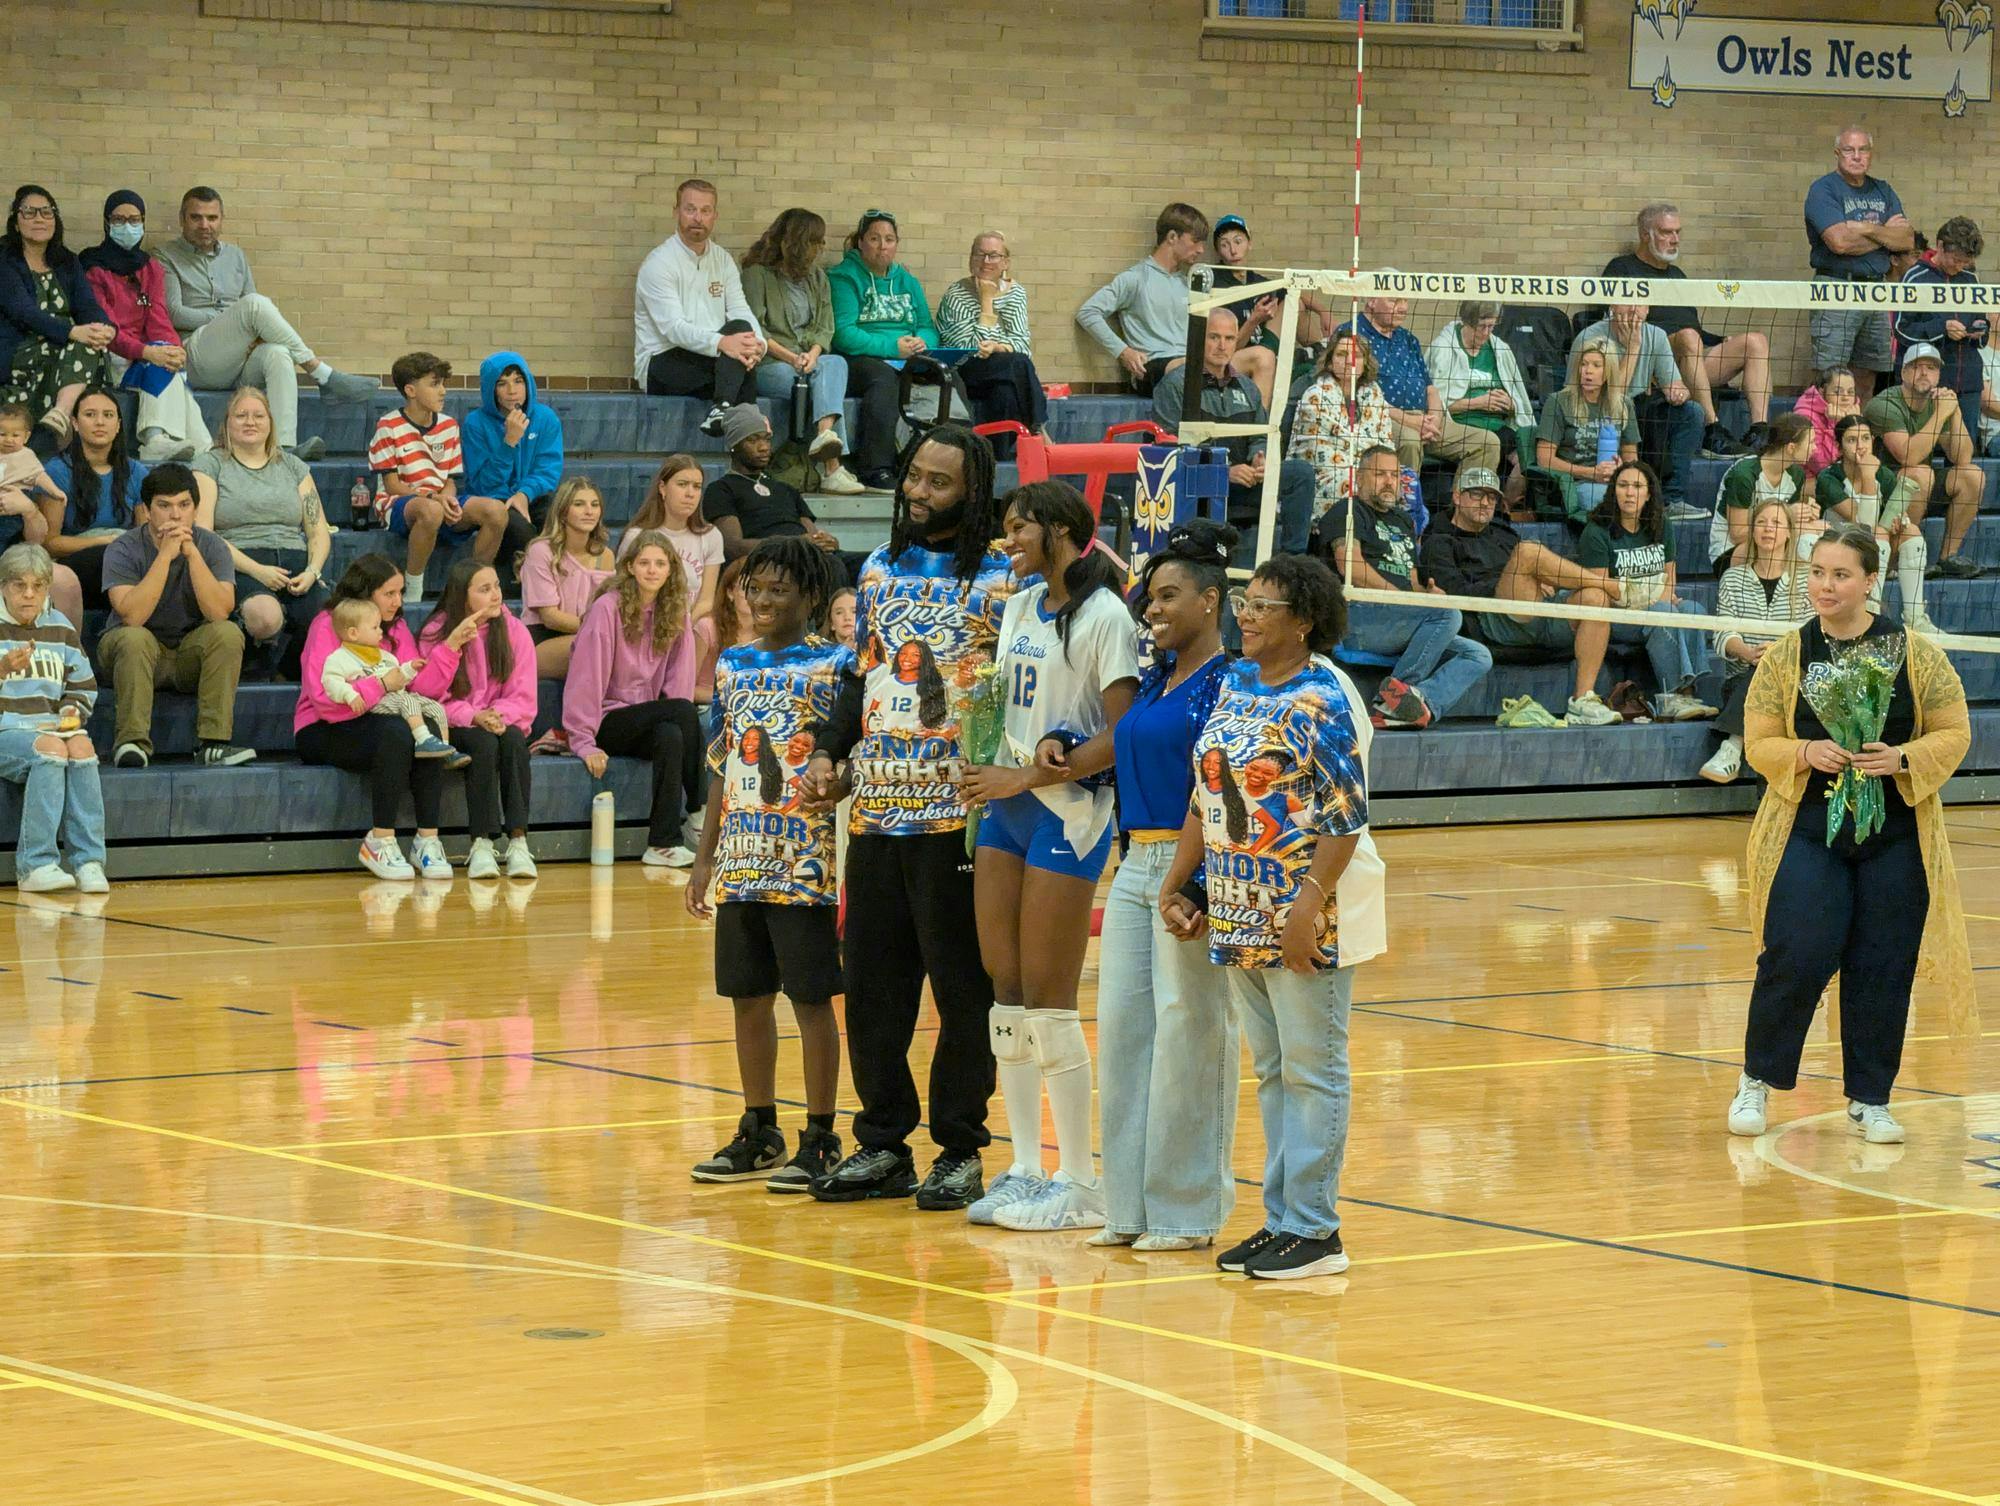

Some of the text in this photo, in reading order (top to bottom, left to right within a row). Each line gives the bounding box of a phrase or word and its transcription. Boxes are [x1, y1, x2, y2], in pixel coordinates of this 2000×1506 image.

[1717, 35, 1912, 80] Owls Nest
[1373, 273, 1651, 298] MUNCIE BURRIS OWLS
[1809, 283, 1918, 303] MUNCIE
[1613, 544, 1666, 568] ARABIANS
[876, 597, 968, 627] Owls
[1009, 635, 1047, 659] Burris
[1013, 663, 1037, 708] 12
[728, 688, 794, 714] Owls
[891, 696, 911, 712] 12
[742, 777, 756, 790] 12
[850, 770, 957, 803] Jamaria
[879, 803, 966, 829] Jackson
[1208, 808, 1221, 823] 12
